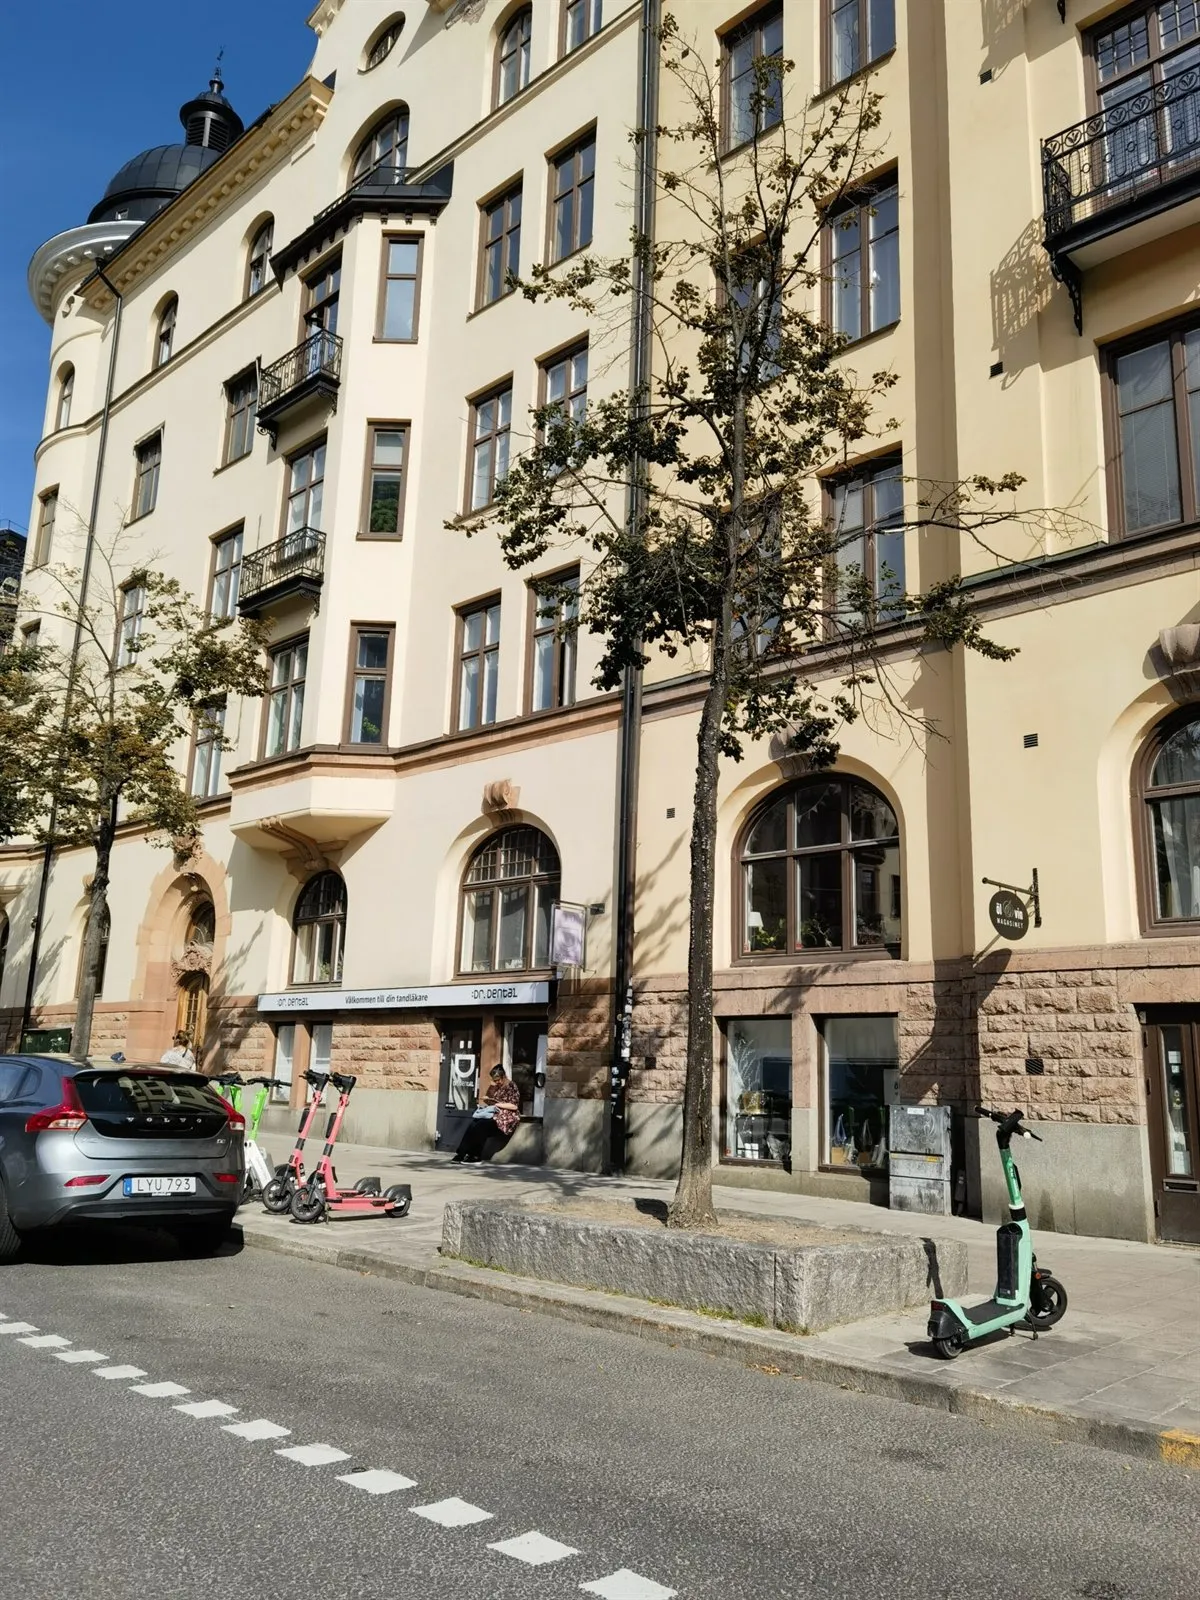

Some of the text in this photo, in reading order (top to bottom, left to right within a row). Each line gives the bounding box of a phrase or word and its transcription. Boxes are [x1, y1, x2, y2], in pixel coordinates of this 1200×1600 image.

[996, 917, 1024, 928] MAGASINET
[345, 993, 429, 1004] Välkommen till din tandläkare
[137, 1178, 191, 1192] LYU 793
